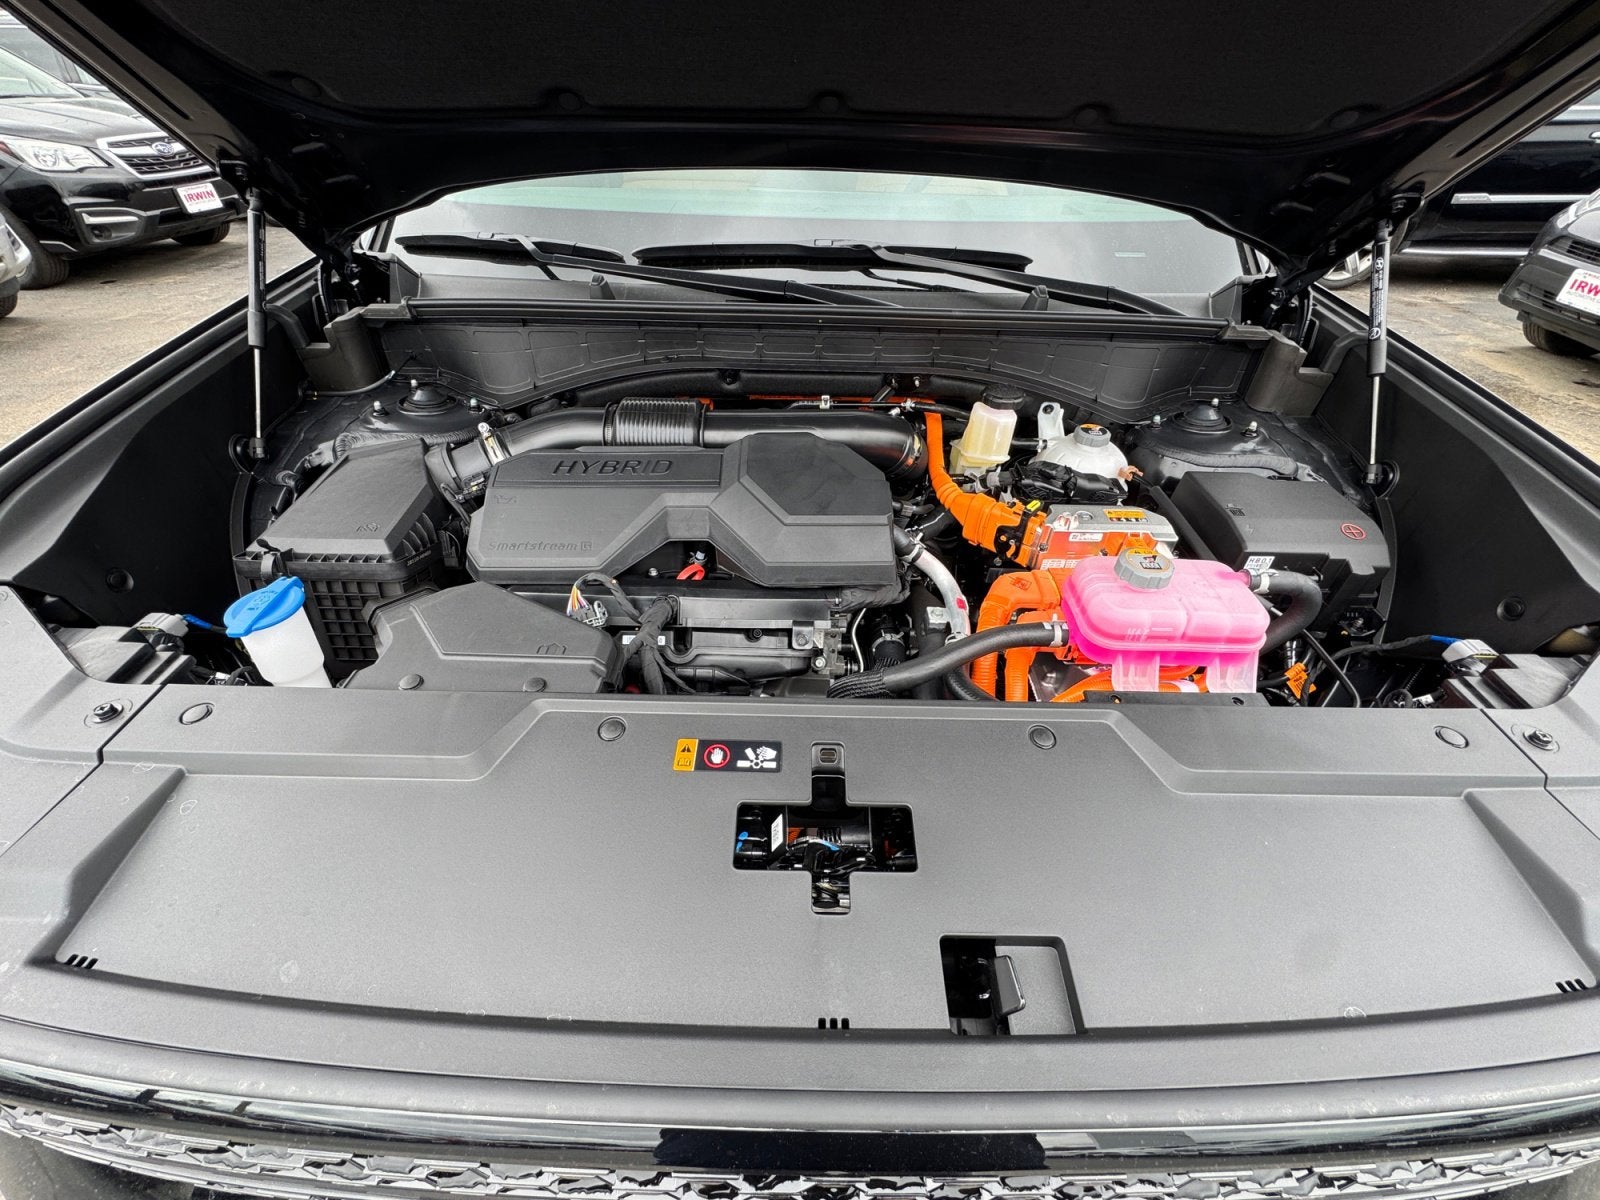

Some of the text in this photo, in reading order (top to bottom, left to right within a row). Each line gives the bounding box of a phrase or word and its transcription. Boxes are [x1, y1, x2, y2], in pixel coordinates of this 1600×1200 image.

[184, 190, 215, 203] IRWIN
[552, 460, 673, 475] HYBRID
[488, 541, 578, 551] Smartstream
